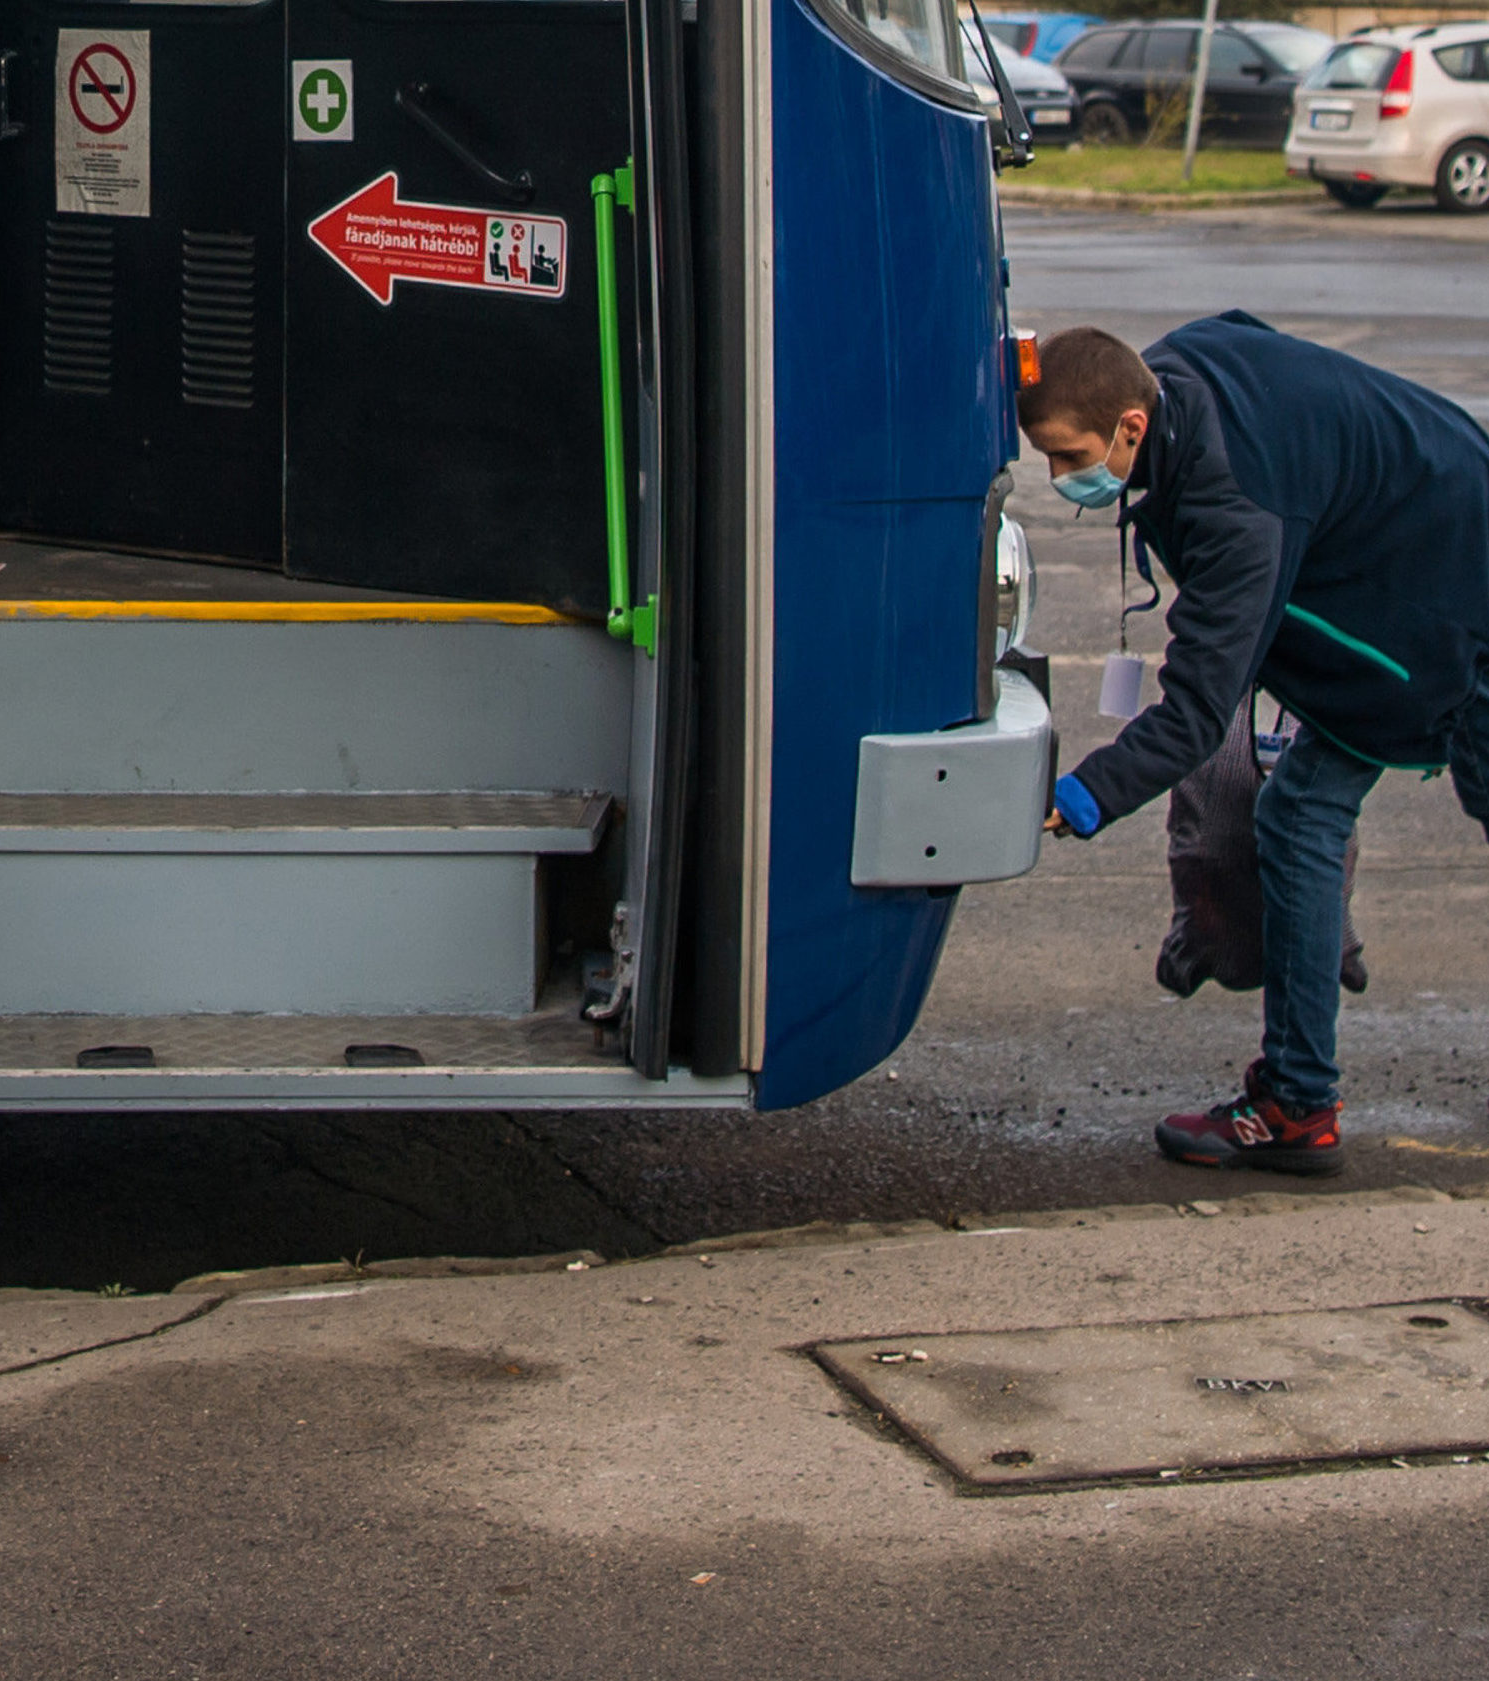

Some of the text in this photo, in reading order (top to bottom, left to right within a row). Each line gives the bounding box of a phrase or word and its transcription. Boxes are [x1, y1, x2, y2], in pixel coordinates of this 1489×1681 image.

[399, 218, 448, 234] lehetséges,
[449, 223, 480, 238] kérjük,
[345, 226, 480, 257] fáradjanak hátrébb!
